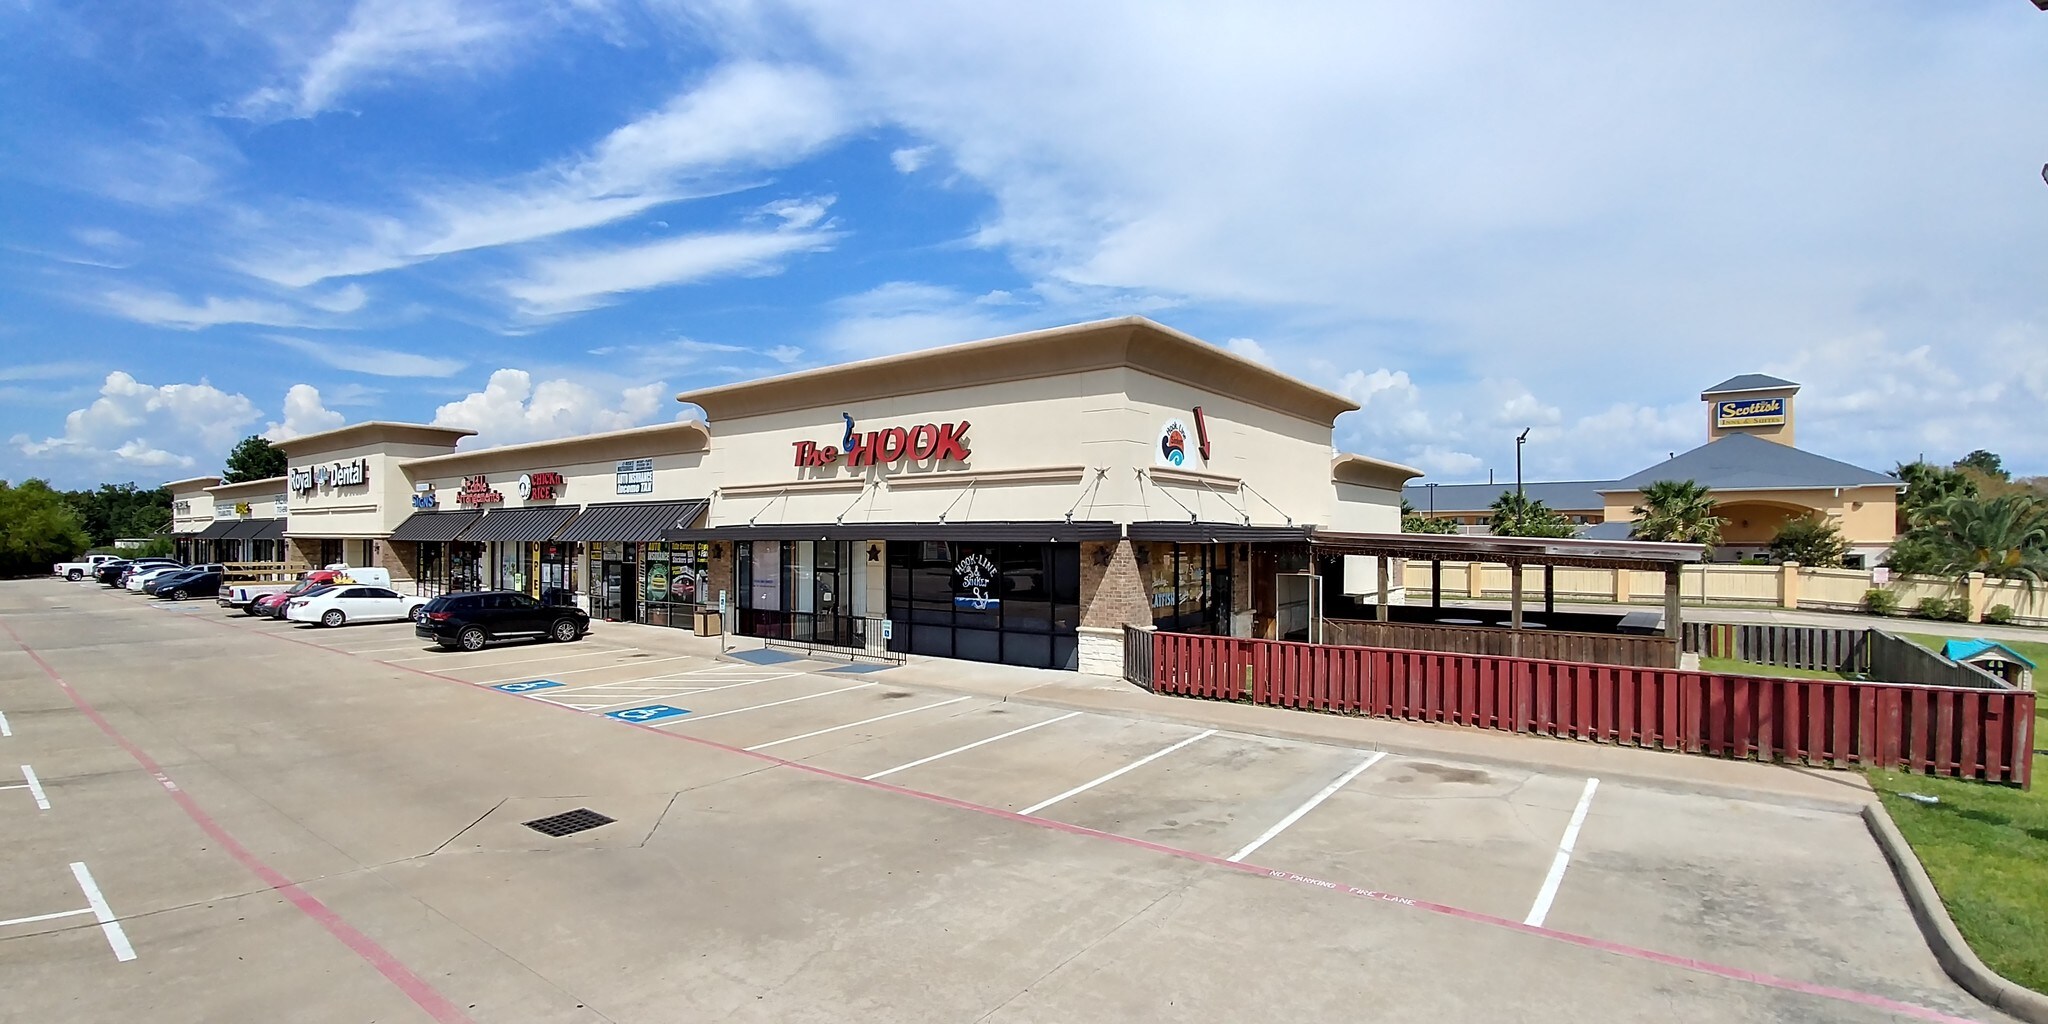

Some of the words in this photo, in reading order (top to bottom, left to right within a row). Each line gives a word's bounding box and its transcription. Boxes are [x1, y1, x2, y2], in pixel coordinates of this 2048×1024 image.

[1721, 400, 1780, 418] Scottish
[1753, 417, 1780, 425] SUITES
[792, 440, 838, 467] The
[847, 420, 972, 467] HOOK
[291, 467, 314, 494] Royal
[331, 459, 366, 486] Dental
[456, 491, 501, 507] Arrangements
[531, 486, 551, 500] RICE
[1269, 870, 1286, 878] NO
[1290, 874, 1336, 889] PARKING
[1348, 887, 1378, 897] FIRE
[1382, 894, 1416, 906] LANE
